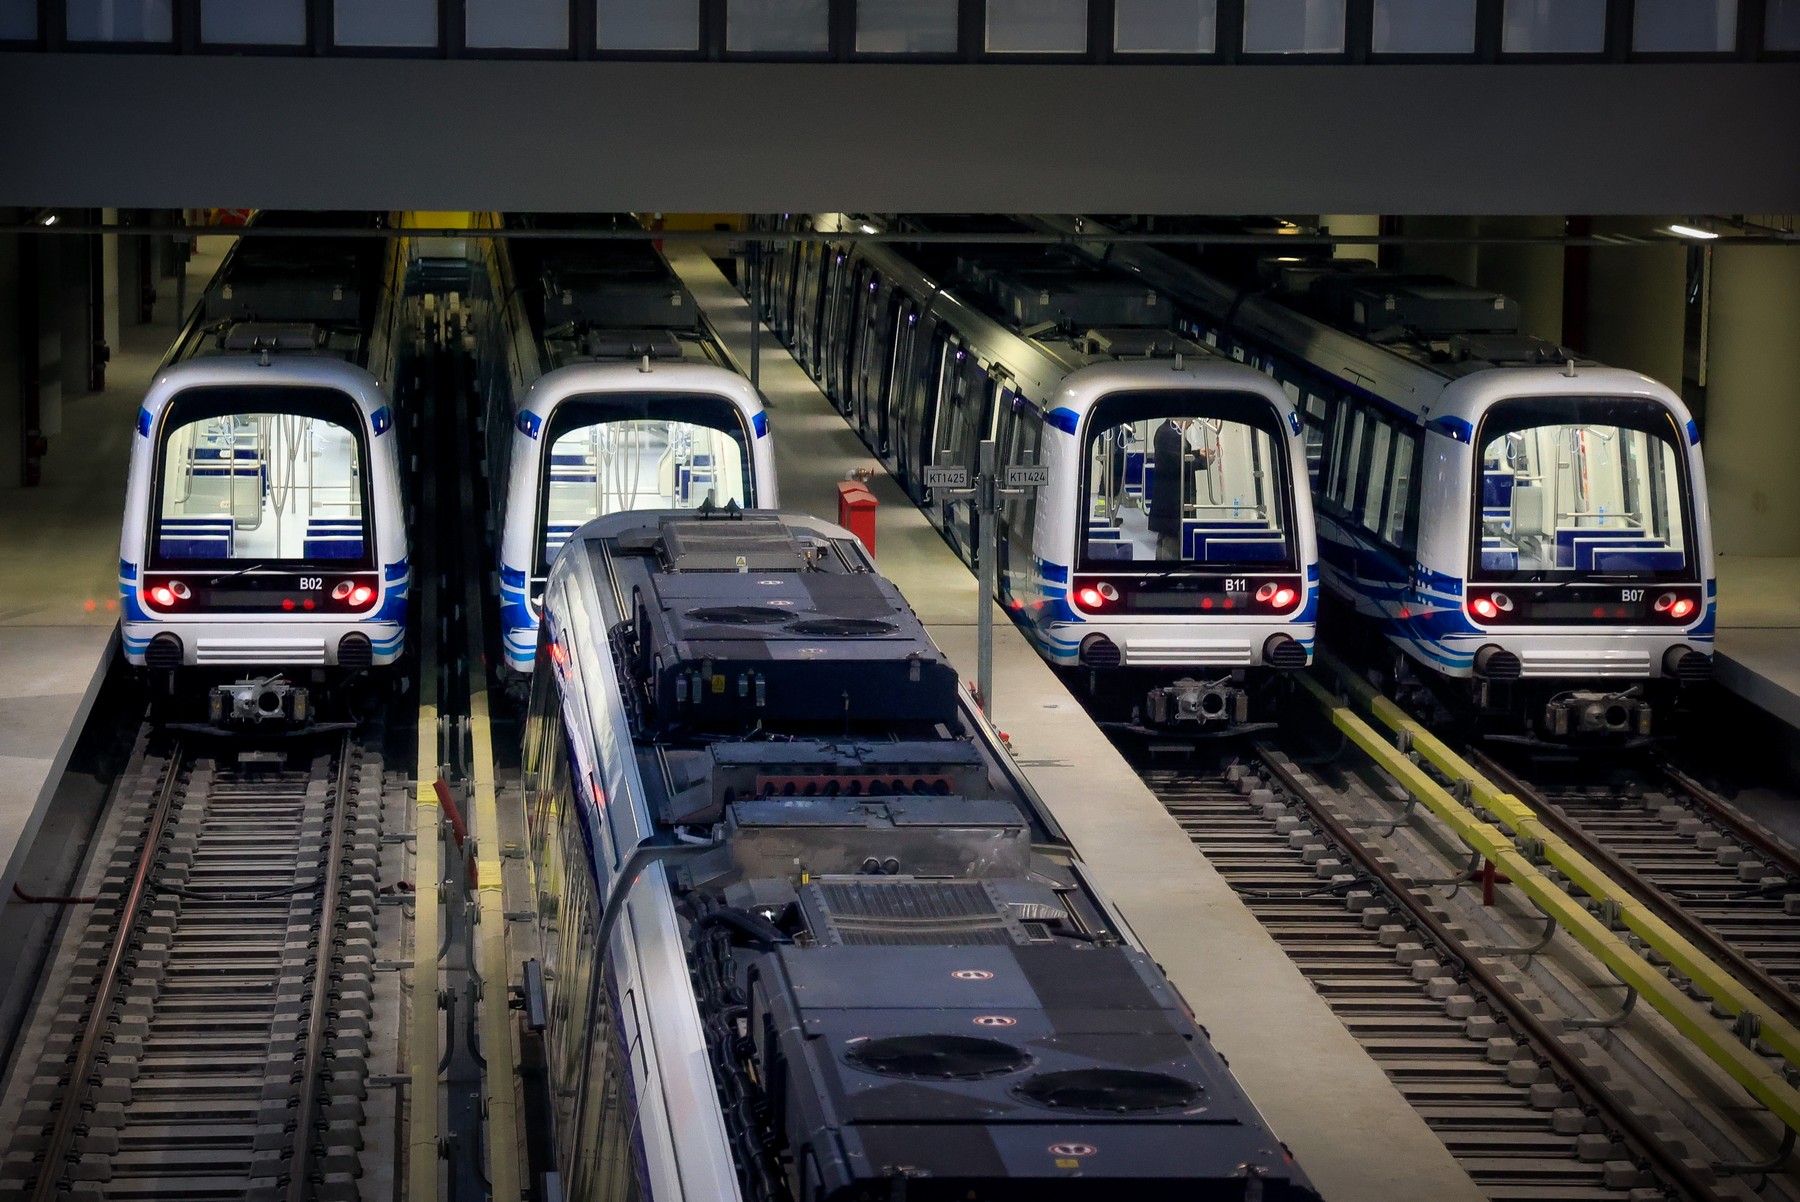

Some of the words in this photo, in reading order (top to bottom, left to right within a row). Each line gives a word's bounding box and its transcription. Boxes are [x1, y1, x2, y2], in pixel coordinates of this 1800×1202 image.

[929, 472, 965, 484] KT1425
[1010, 472, 1045, 482] KT1424
[300, 577, 323, 590] B02
[1225, 578, 1246, 591] B11
[1621, 589, 1645, 602] B07
